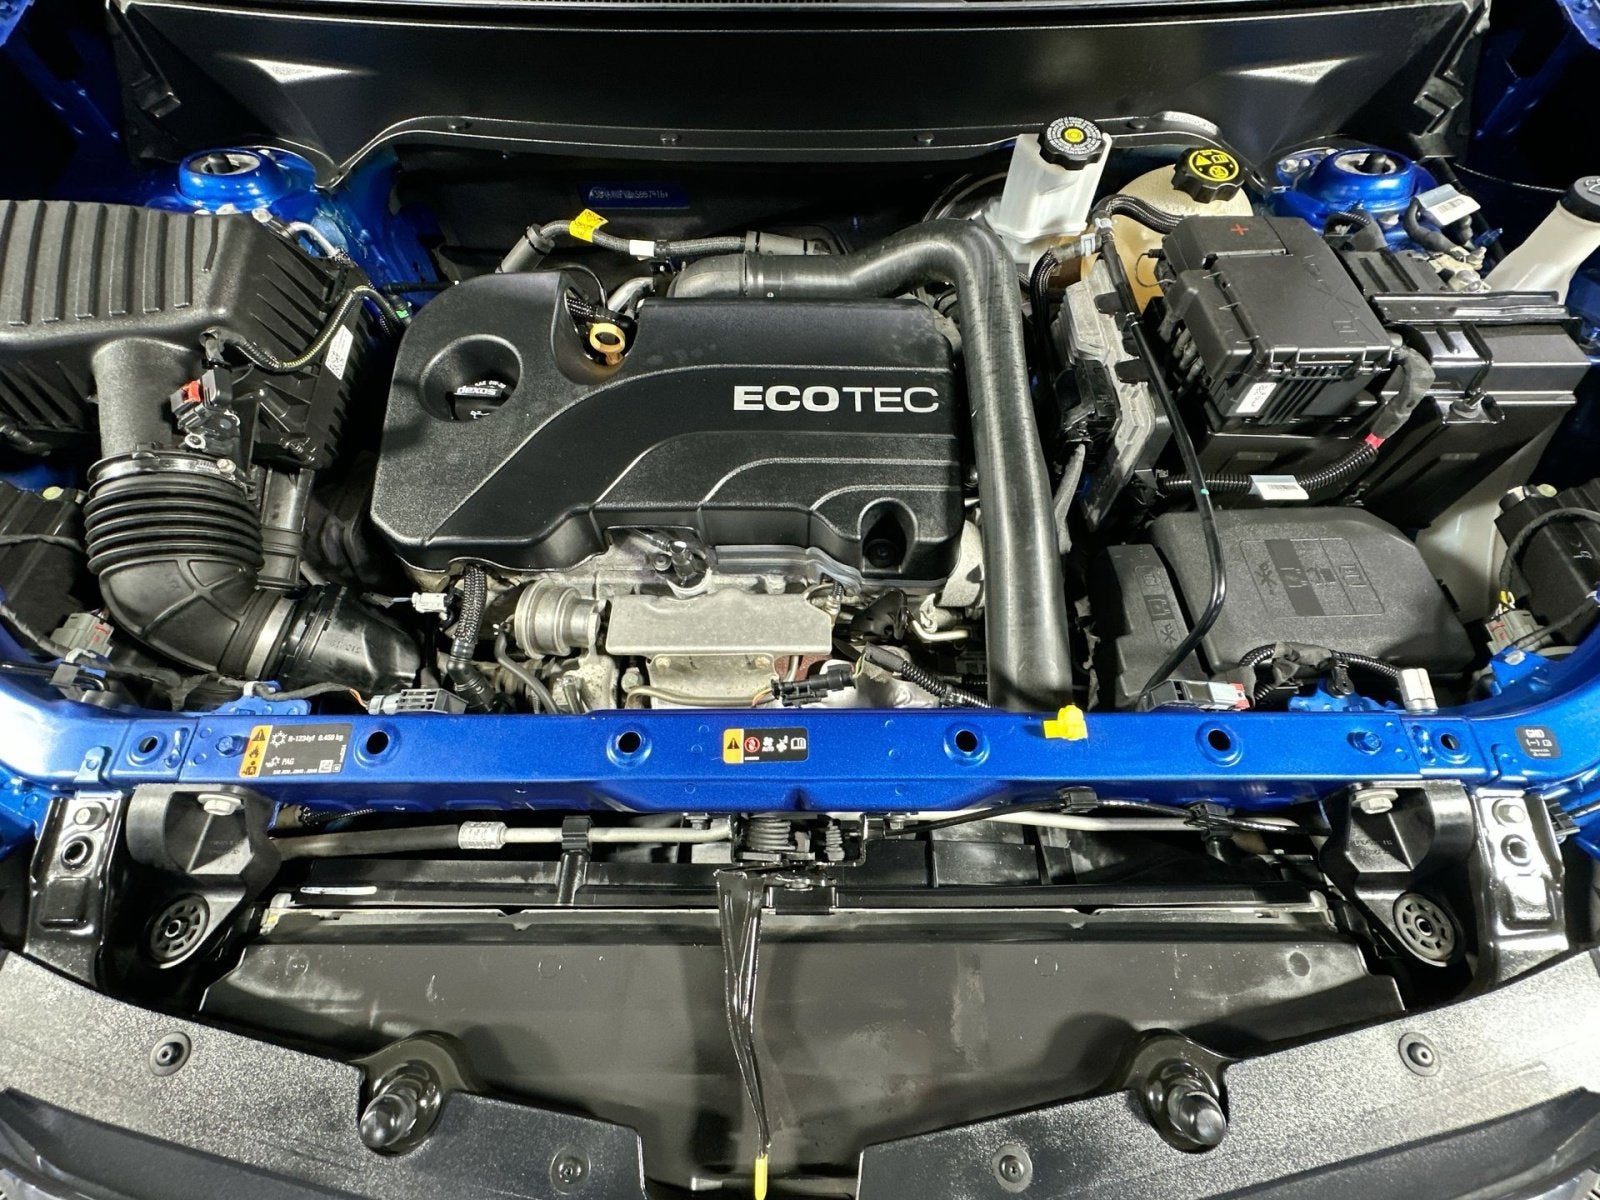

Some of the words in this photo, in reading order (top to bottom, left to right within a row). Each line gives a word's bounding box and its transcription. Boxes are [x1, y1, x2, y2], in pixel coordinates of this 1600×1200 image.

[456, 385, 498, 396] dexos
[733, 385, 940, 413] ECOTEC
[335, 733, 344, 742] kg
[281, 758, 295, 766] PAG
